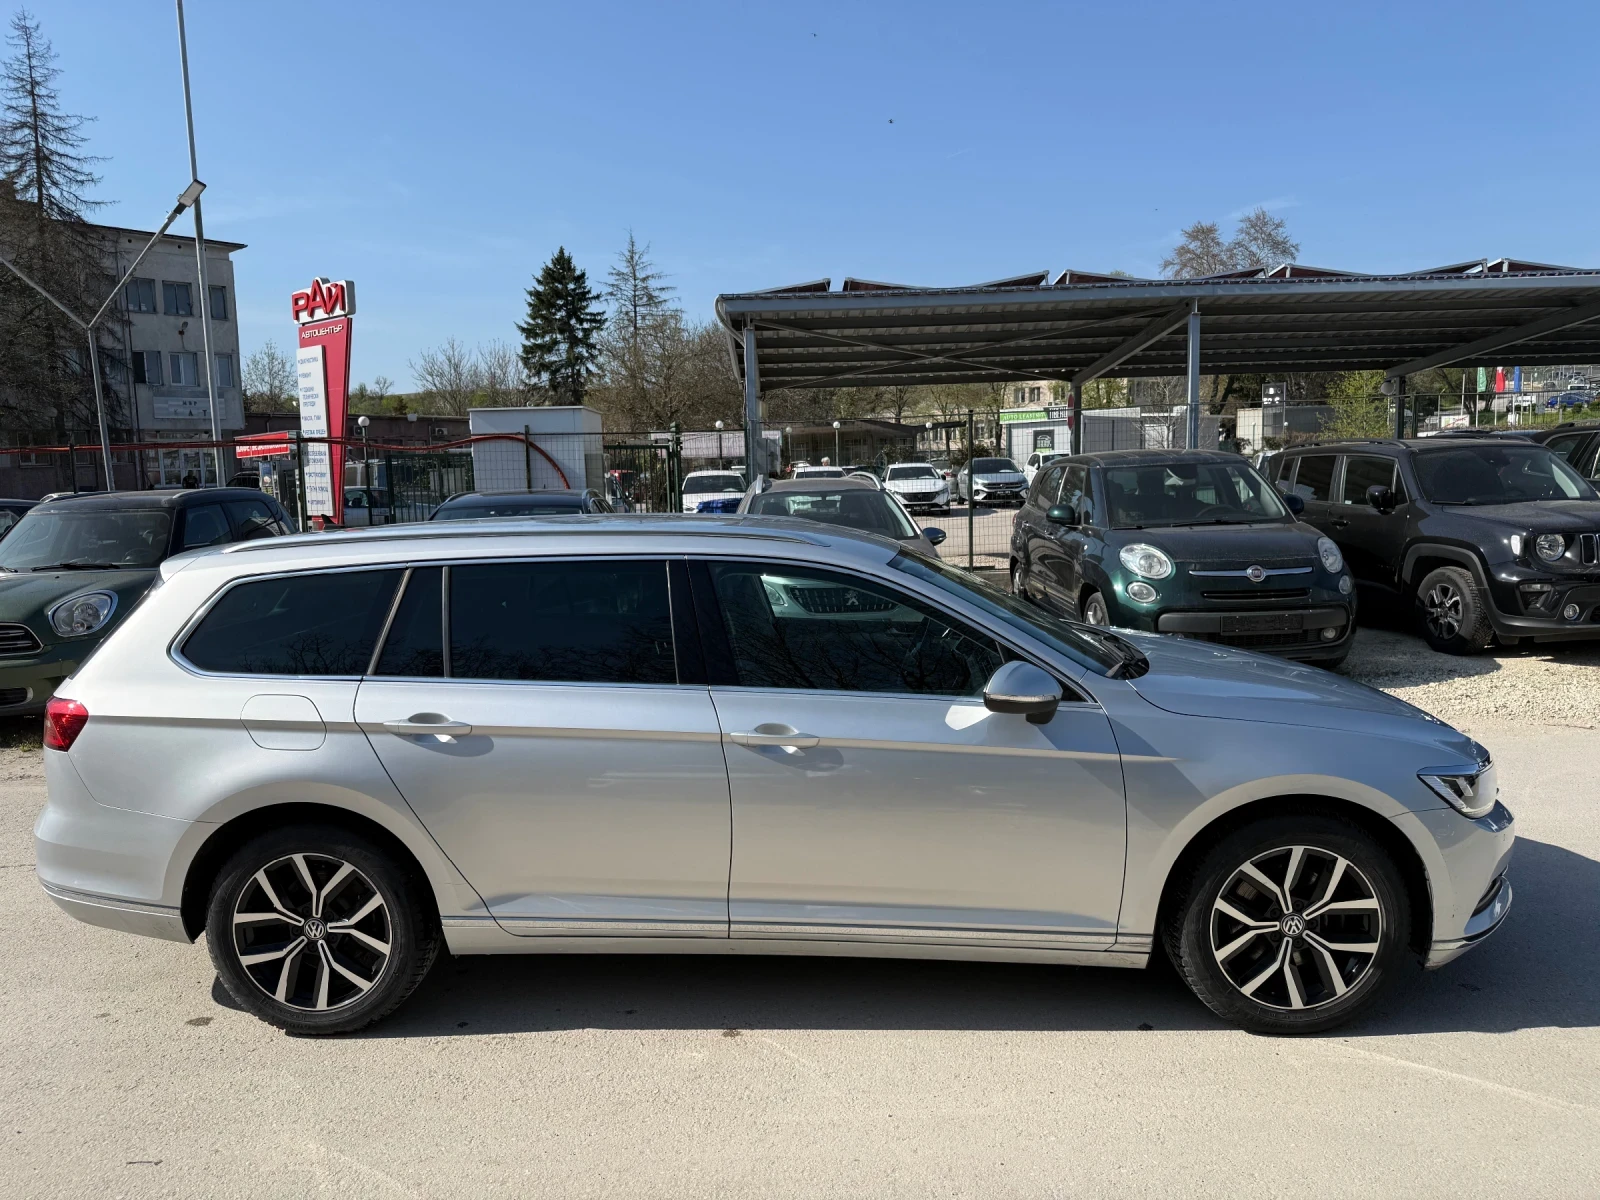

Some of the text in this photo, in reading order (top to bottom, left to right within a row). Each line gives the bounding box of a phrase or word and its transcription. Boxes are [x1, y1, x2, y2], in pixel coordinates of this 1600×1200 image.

[292, 279, 344, 321] РАЙ
[301, 324, 343, 338] АВТОЦЕНТЪР
[305, 920, 325, 938] VW
